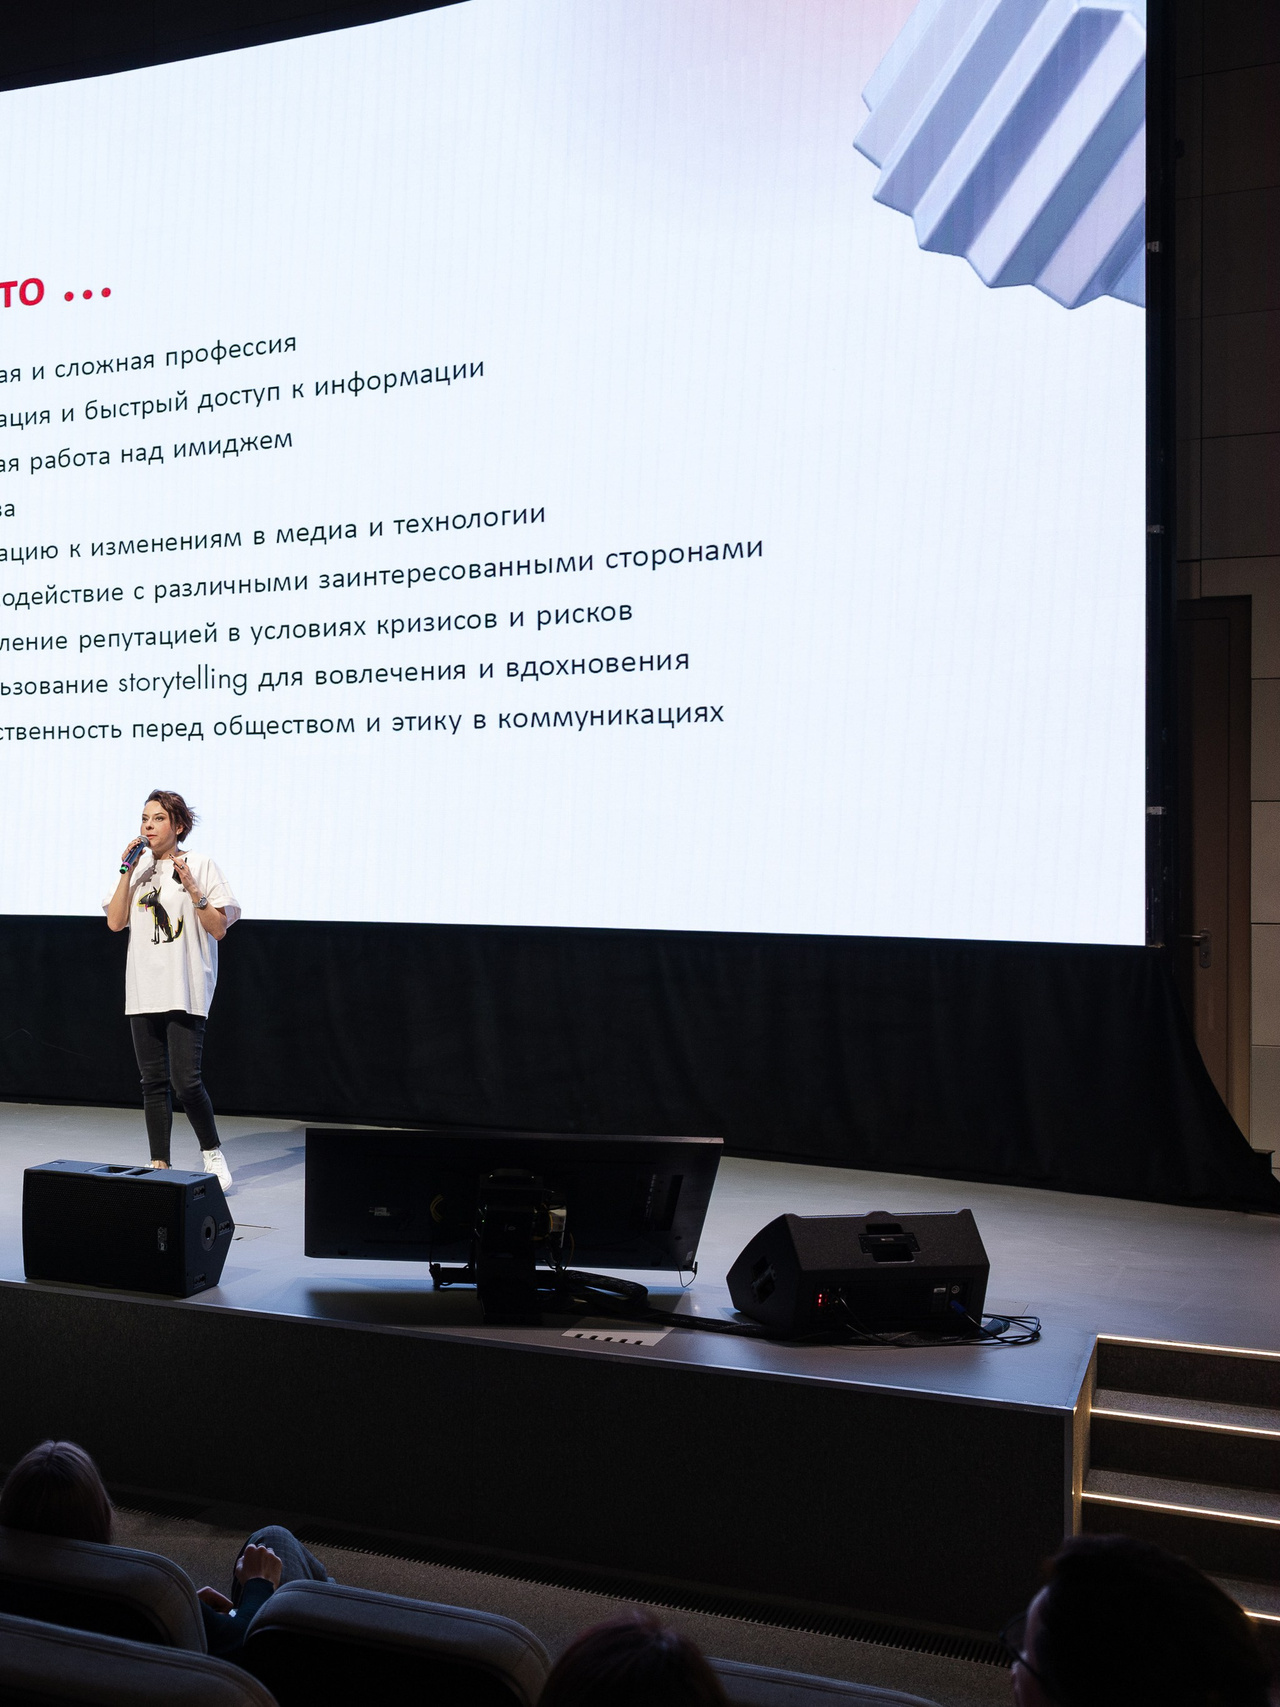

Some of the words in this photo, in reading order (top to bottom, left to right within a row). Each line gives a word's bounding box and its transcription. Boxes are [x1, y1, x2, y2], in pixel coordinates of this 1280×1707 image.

[32, 365, 45, 381] и
[54, 353, 155, 378] сложная
[165, 336, 296, 370] профессия
[61, 407, 74, 423] и
[84, 389, 188, 421] быстрый
[197, 385, 280, 414] доступ
[292, 382, 305, 399] к
[315, 360, 484, 398] информации
[30, 447, 110, 476] работа
[121, 445, 164, 466] над
[173, 432, 293, 459] имиджем
[70, 543, 82, 558] к
[91, 531, 242, 557] изменениям
[253, 530, 266, 546] в
[276, 523, 357, 547] медиа
[369, 520, 383, 537] и
[392, 506, 545, 535] технологии
[133, 585, 145, 600] с
[154, 575, 308, 604] различными
[318, 554, 593, 589] заинтересованными
[605, 540, 763, 572] сторонами
[79, 621, 217, 654] репутацией
[228, 626, 241, 642] в
[250, 620, 367, 646] условиях
[377, 612, 498, 639] кризисов
[509, 610, 524, 628] и
[537, 604, 633, 631] рисков
[118, 663, 248, 699] storytelling
[257, 670, 303, 693] для
[315, 663, 466, 686] вовлечения
[479, 662, 494, 679] и
[506, 653, 689, 683] вдохновения
[132, 721, 204, 743] перед
[213, 714, 355, 740] обществом
[366, 716, 380, 733] и
[392, 714, 463, 736] этику
[473, 713, 487, 730] в
[498, 705, 725, 732] коммуникациях
